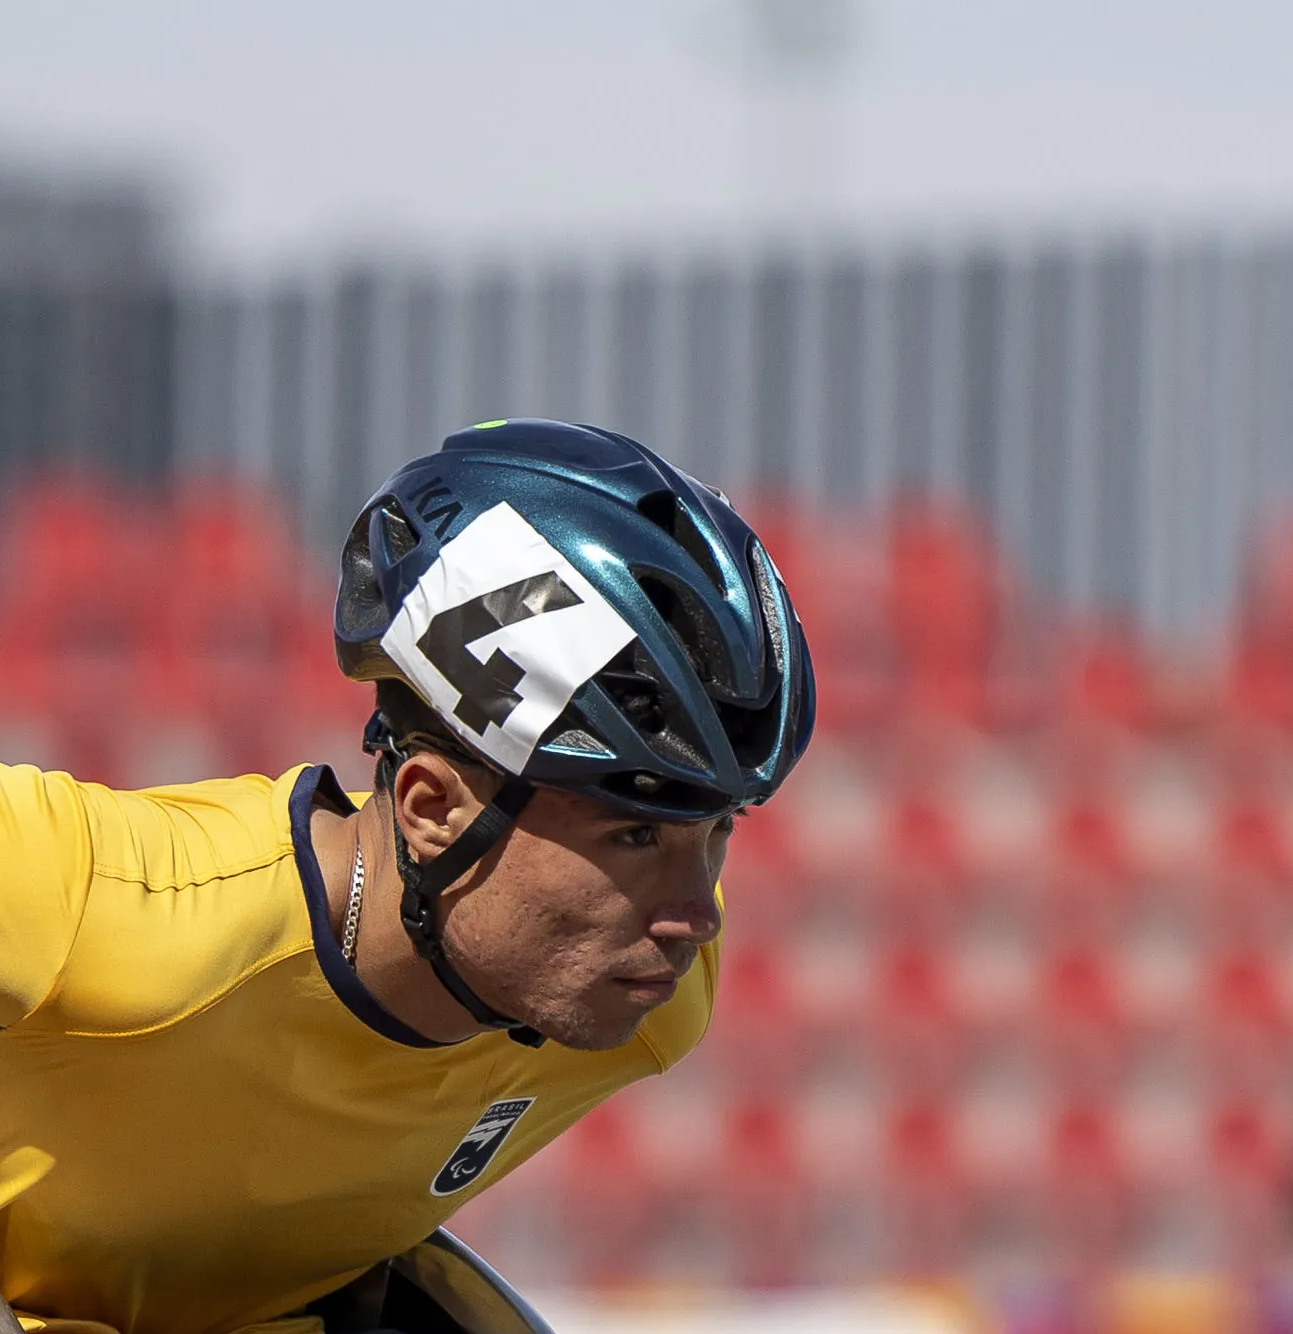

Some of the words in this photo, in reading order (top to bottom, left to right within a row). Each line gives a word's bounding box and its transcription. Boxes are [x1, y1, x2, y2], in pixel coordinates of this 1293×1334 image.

[408, 476, 464, 546] KA
[416, 570, 584, 736] 4
[487, 1103, 524, 1114] BRASIL
